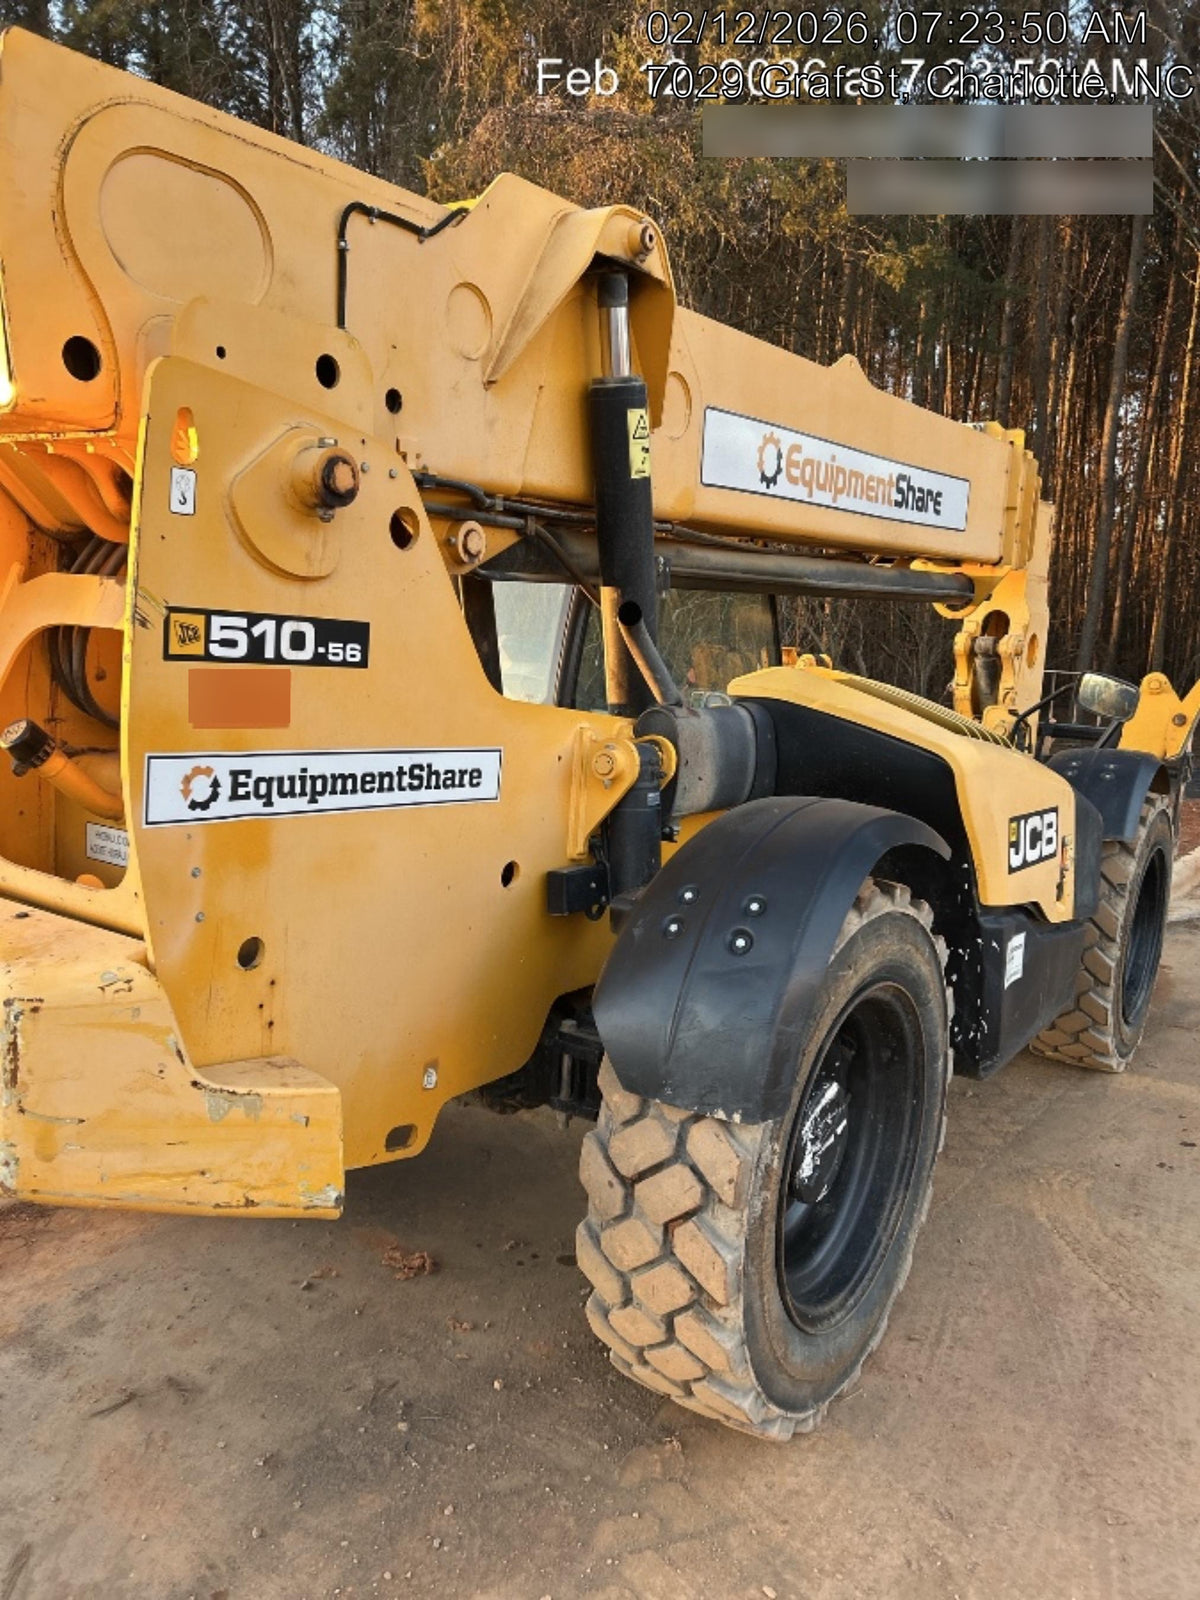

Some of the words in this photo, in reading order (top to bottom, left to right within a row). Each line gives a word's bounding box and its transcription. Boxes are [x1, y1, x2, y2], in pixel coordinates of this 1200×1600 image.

[785, 443, 943, 517] EquipmentShare
[207, 614, 363, 663] 510-56
[228, 763, 483, 807] EquipmentShare
[1009, 811, 1057, 869] JCB
